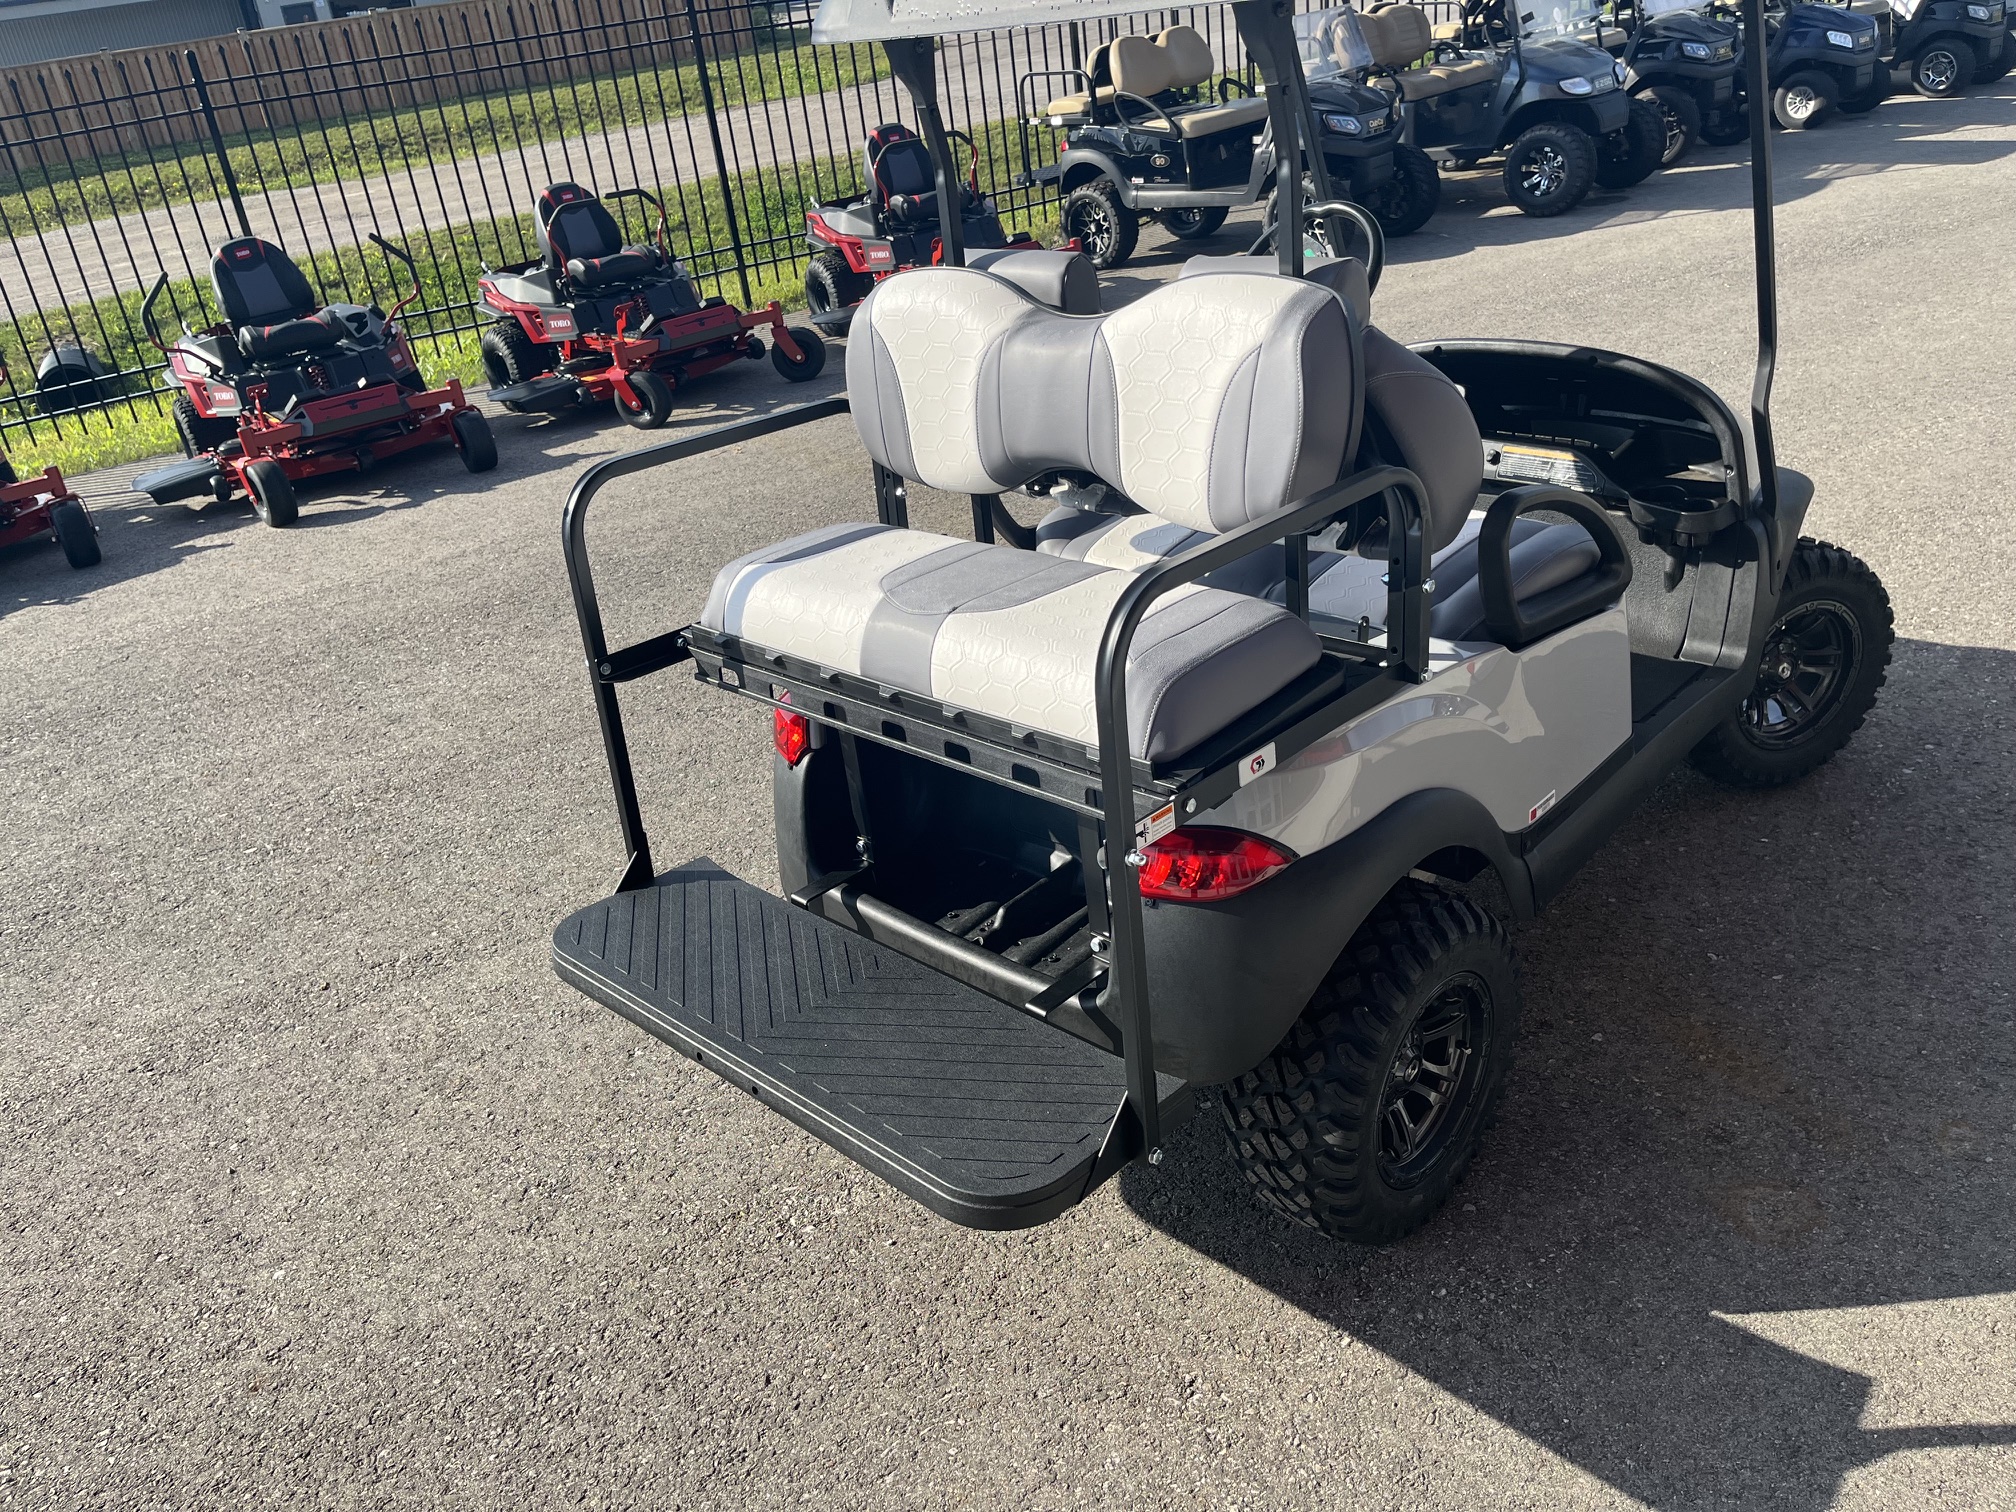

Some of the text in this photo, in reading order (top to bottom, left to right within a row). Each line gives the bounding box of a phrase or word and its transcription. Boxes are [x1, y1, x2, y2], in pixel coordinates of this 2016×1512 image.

[870, 250, 889, 259] TORO
[549, 319, 570, 328] TORO
[214, 391, 234, 400] TORO
